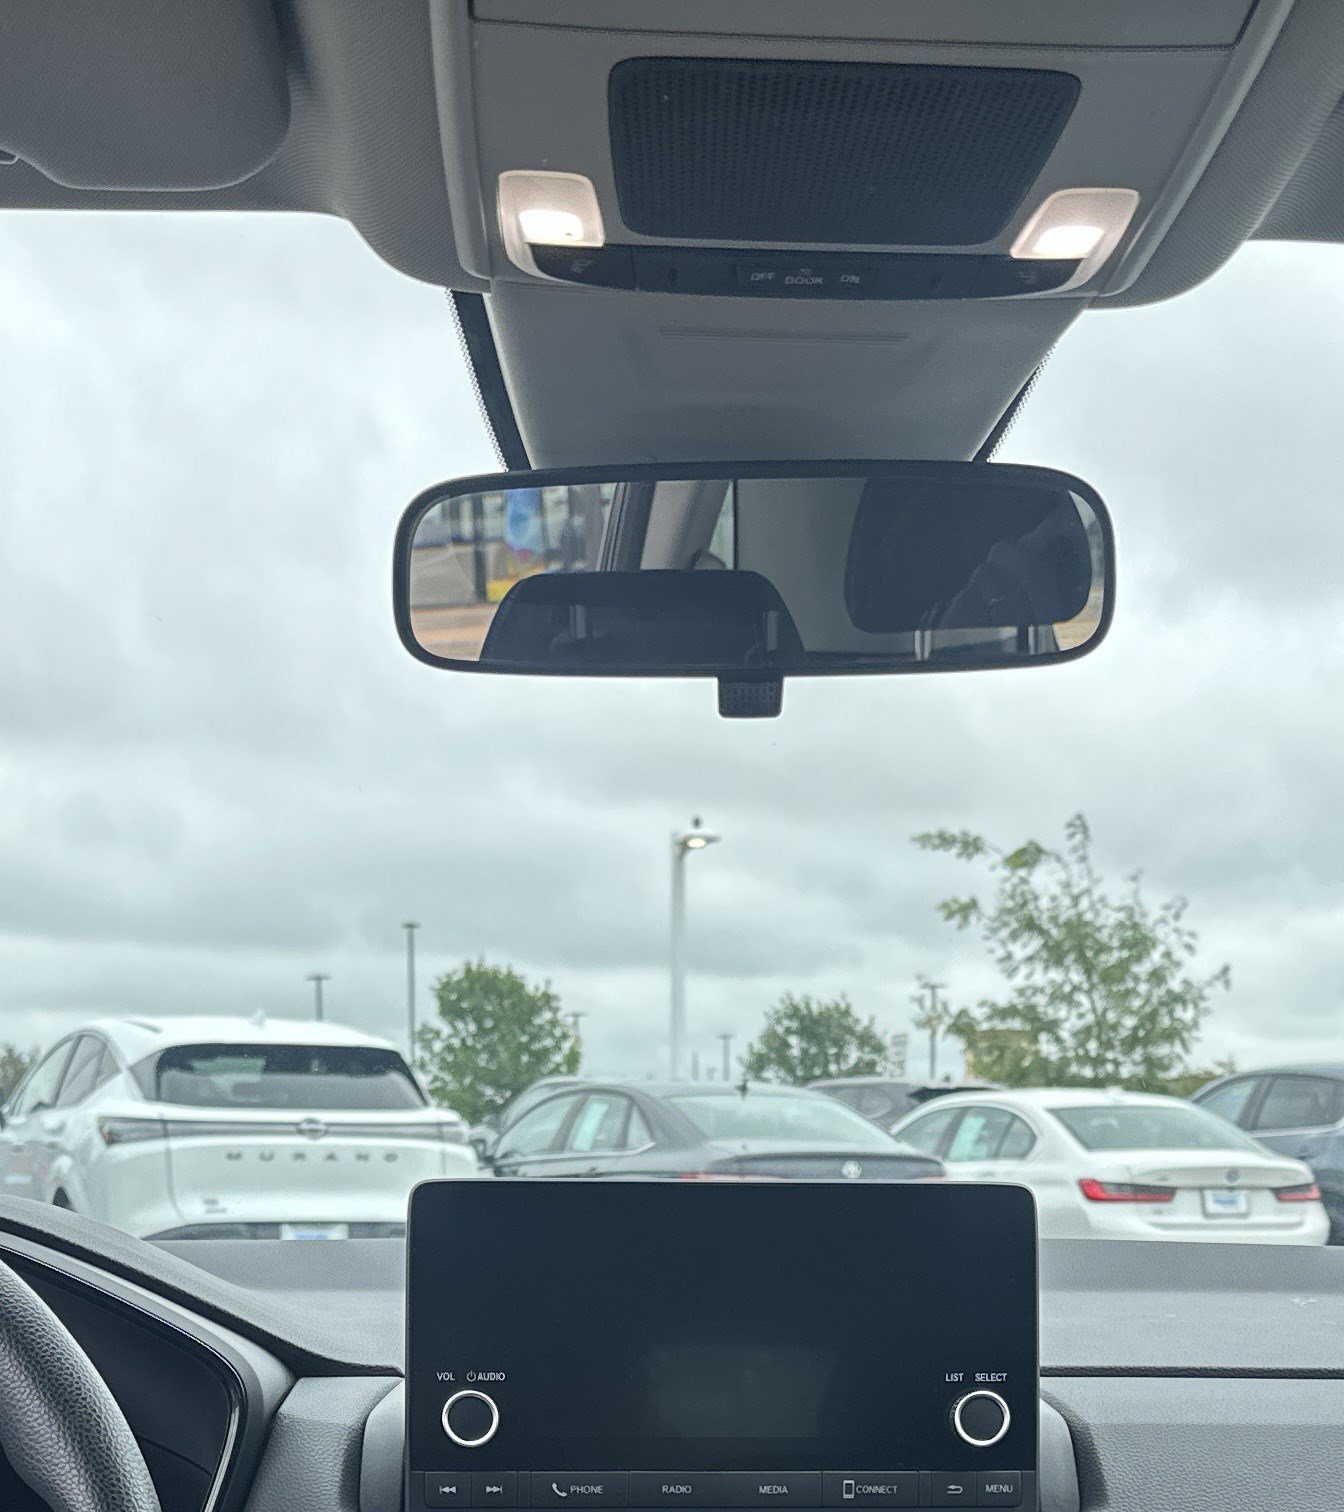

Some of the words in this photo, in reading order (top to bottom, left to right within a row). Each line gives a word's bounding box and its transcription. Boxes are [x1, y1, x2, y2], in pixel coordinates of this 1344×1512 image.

[226, 1152, 399, 1162] MURANO
[436, 1371, 455, 1382] VOL
[477, 1371, 506, 1382] AUDIO
[945, 1373, 964, 1382] LIST
[974, 1373, 1008, 1382] SELECT
[569, 1485, 604, 1494] PHONE
[662, 1485, 692, 1494] RADIO
[759, 1485, 789, 1494] MEDIA
[856, 1485, 898, 1494] CONNECT
[985, 1484, 1013, 1494] MENU
